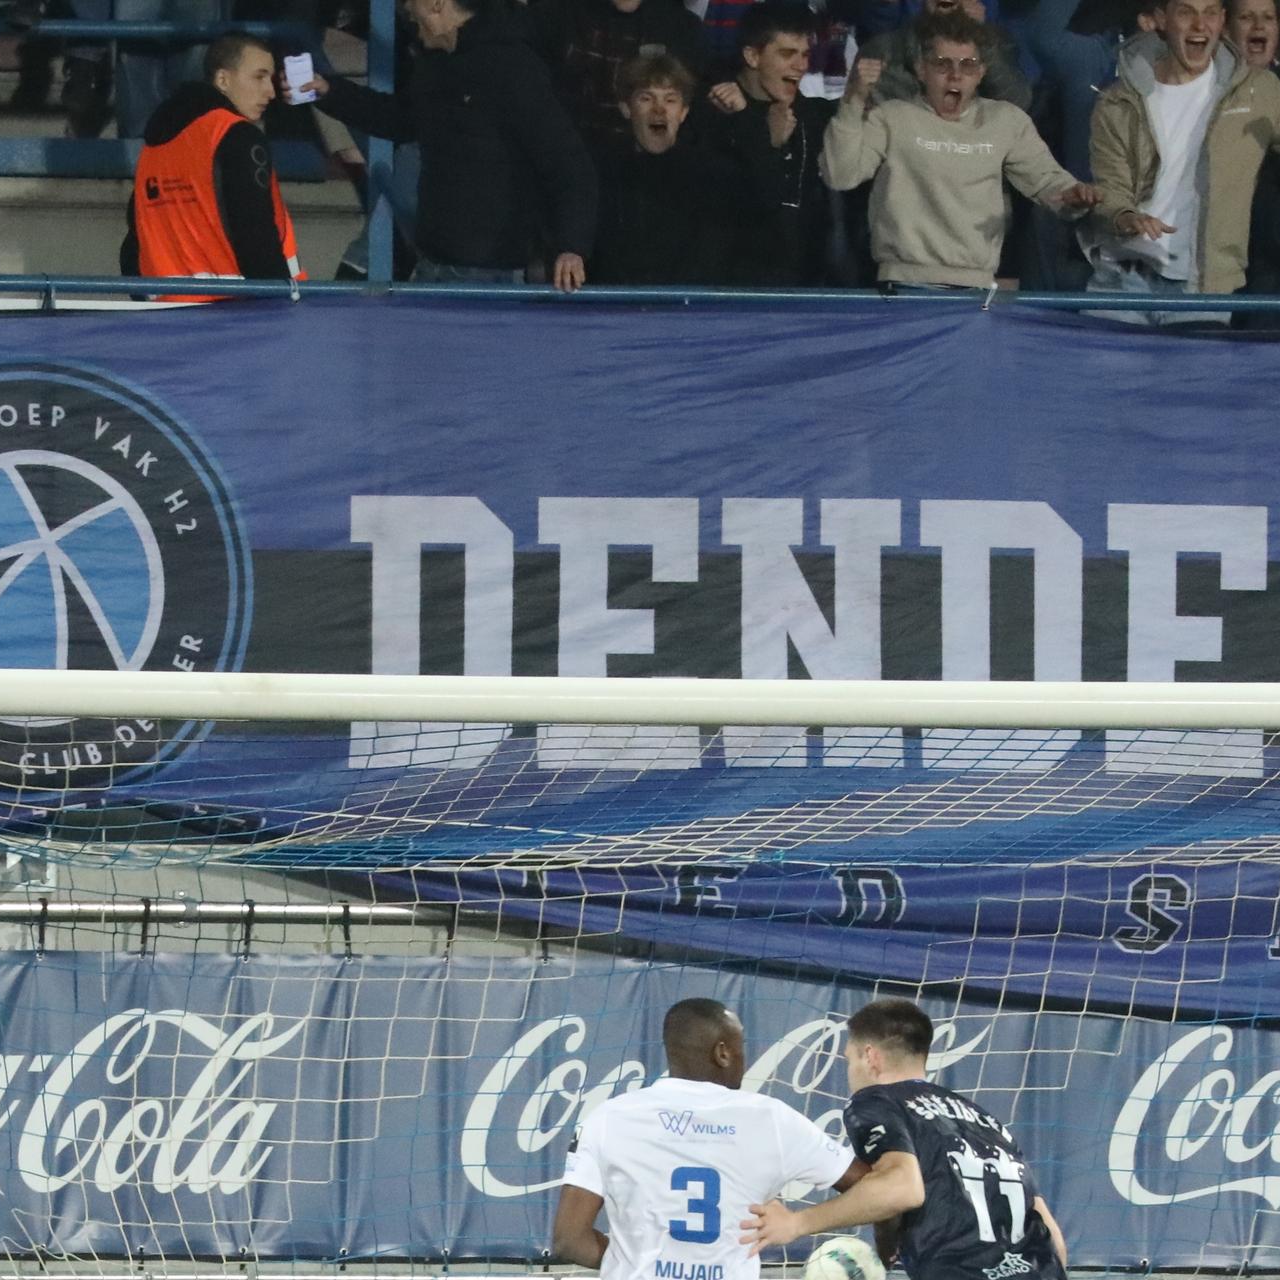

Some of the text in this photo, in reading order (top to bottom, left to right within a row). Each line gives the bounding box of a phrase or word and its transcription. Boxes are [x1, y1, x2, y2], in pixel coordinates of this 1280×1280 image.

[94, 416, 158, 477] VAK
[164, 488, 198, 535] H2
[20, 743, 103, 776] CLUB
[692, 1123, 736, 1135] WILMS
[669, 1166, 721, 1244] 3
[947, 1138, 1026, 1245] 11
